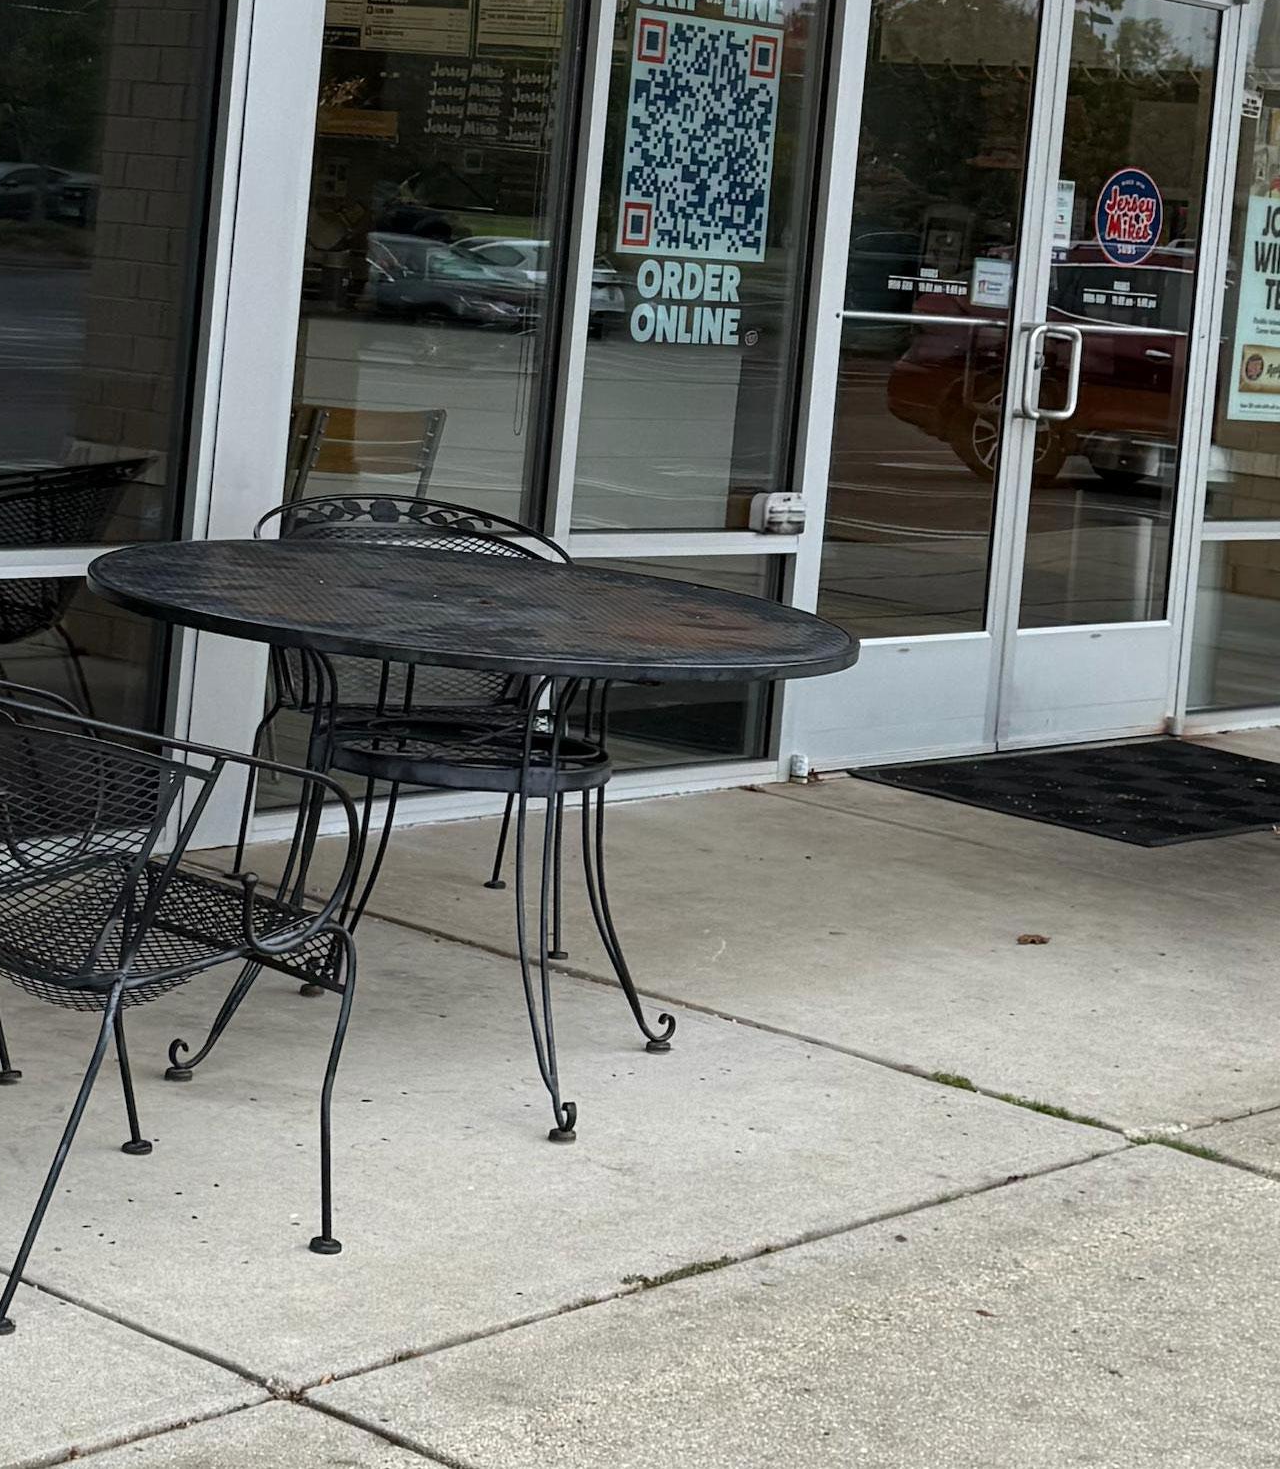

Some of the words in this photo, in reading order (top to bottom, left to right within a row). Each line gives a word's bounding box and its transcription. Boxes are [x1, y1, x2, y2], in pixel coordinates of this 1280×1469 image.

[1105, 185, 1156, 224] Jersey
[637, 259, 741, 302] ORDER
[630, 303, 741, 345] ONLINE
